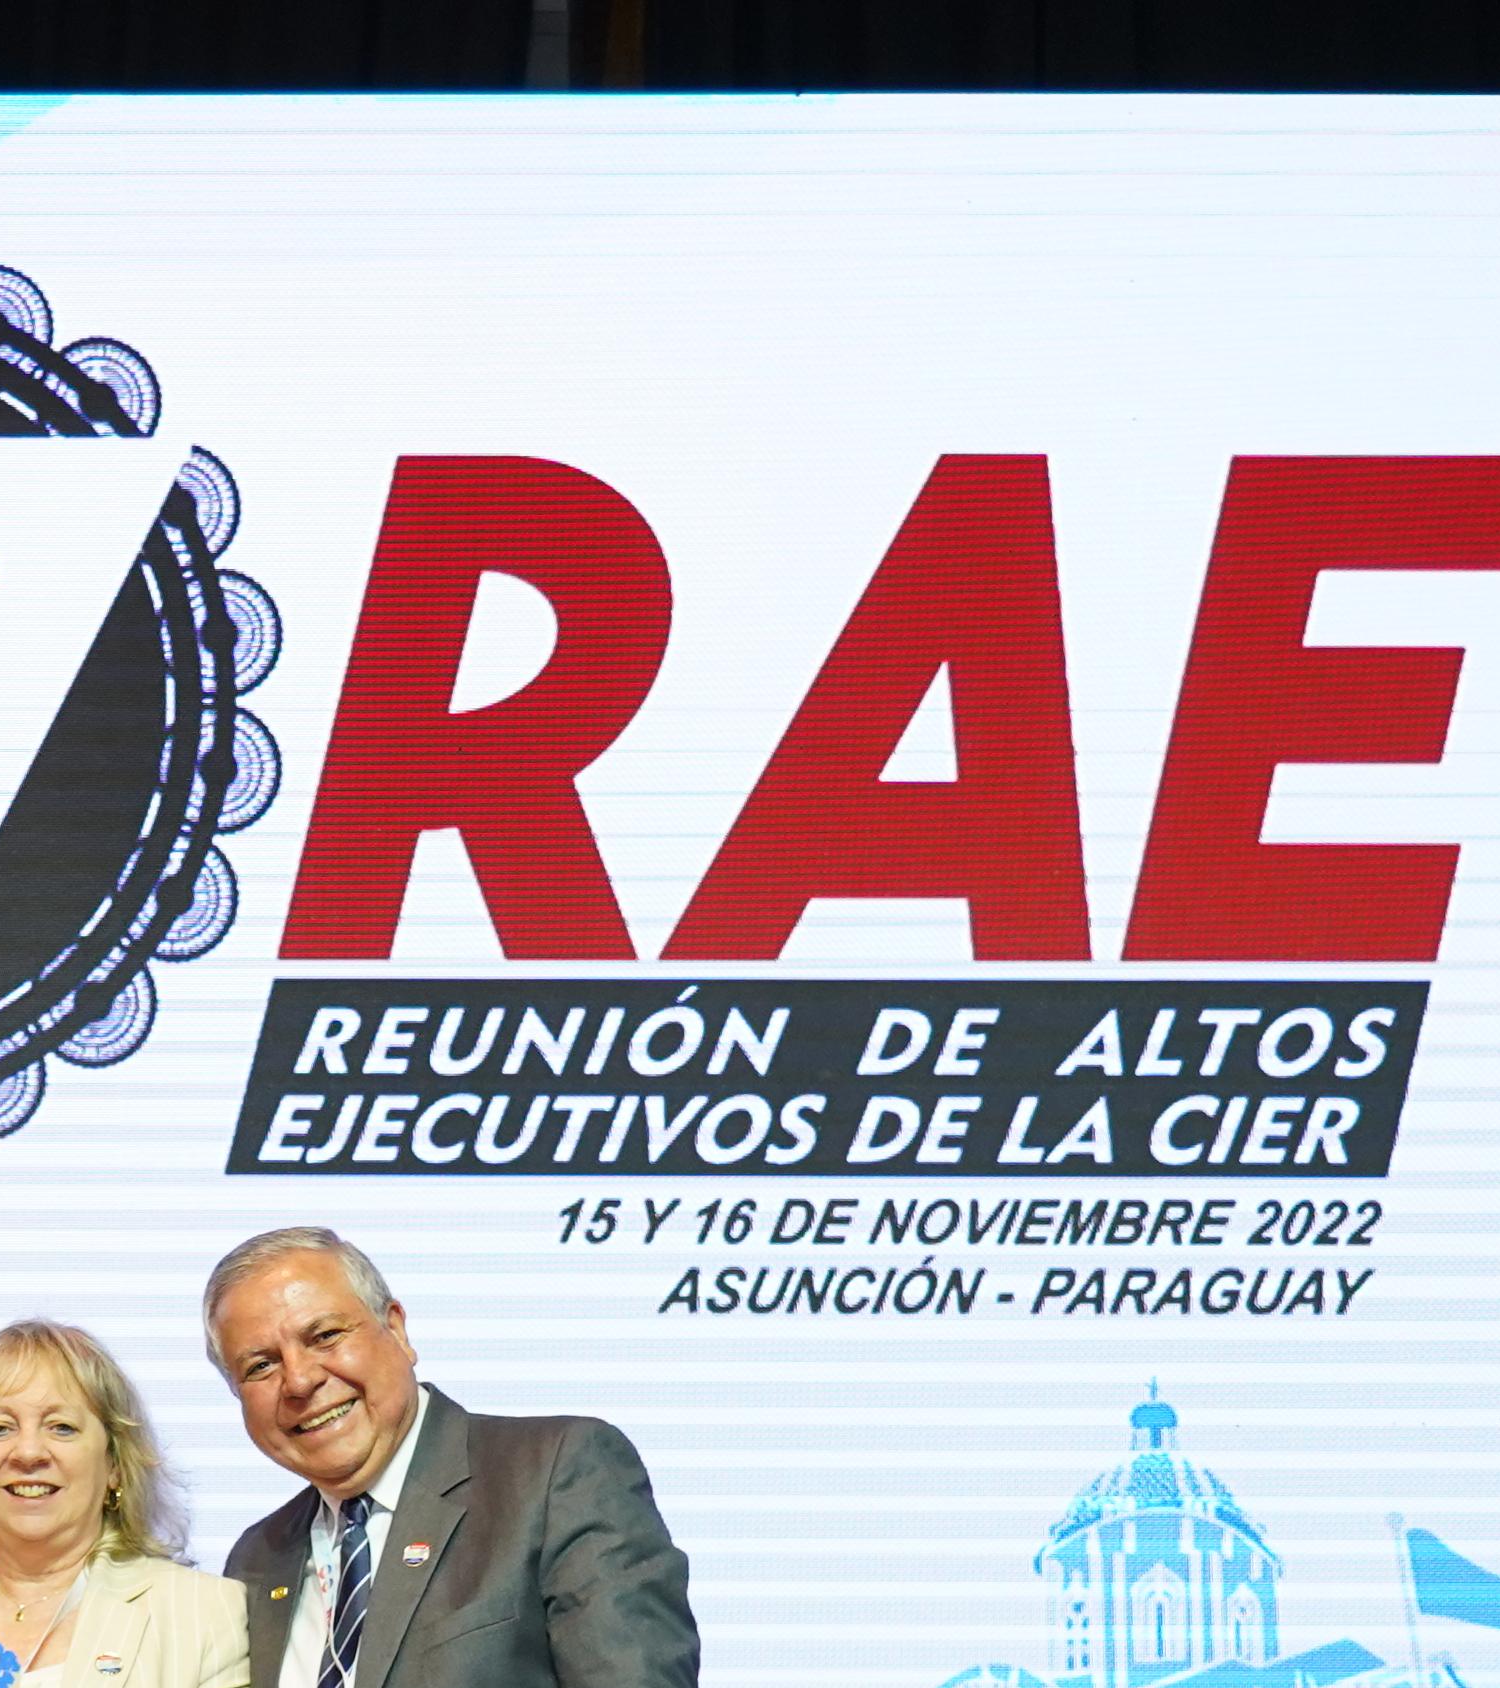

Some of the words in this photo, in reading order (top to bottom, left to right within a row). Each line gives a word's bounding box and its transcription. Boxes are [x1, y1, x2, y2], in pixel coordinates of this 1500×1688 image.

[293, 985, 790, 1076] REUNIÓN
[856, 1008, 1000, 1077] DE
[1055, 1008, 1396, 1078] ALTOS
[257, 1094, 826, 1164] EJECUTIVOS
[846, 1096, 982, 1164] DE
[997, 1096, 1114, 1165] LA
[1148, 1095, 1361, 1165] CIER
[559, 1199, 620, 1244] 15
[642, 1199, 681, 1244] Y
[696, 1199, 757, 1245] 16
[769, 1199, 858, 1245] DE
[869, 1199, 1236, 1246] NOVIEMBRE
[1248, 1200, 1382, 1246] 2022
[658, 1256, 984, 1315] ASUNCIÓN
[1031, 1268, 1373, 1315] PARAGUAY
